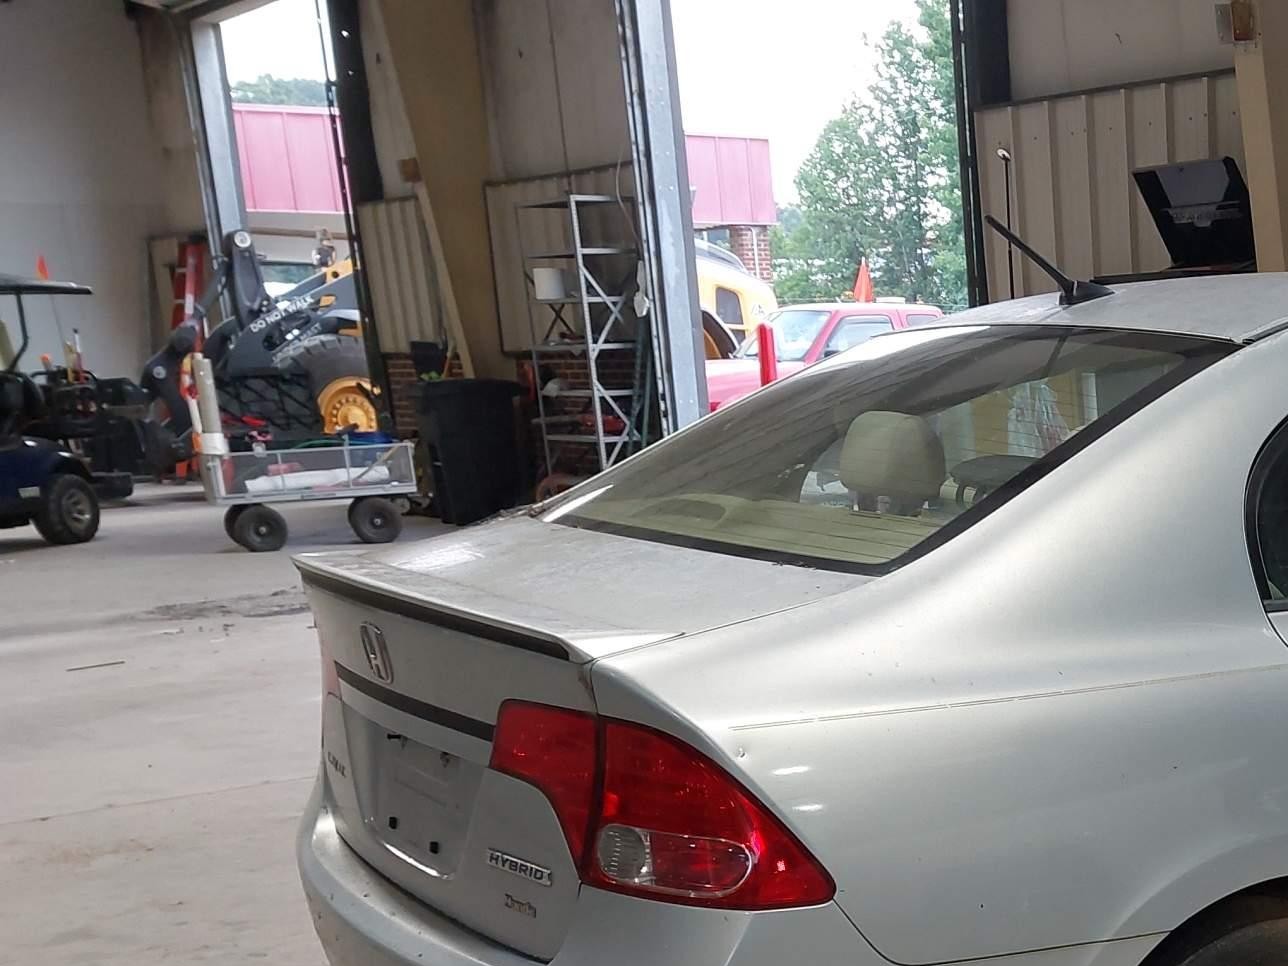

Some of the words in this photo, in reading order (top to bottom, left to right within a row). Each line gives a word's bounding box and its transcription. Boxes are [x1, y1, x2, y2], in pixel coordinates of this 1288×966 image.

[250, 319, 266, 333] DO
[265, 307, 286, 324] NOT
[285, 296, 315, 312] WALK
[489, 853, 544, 880] HYBRID
